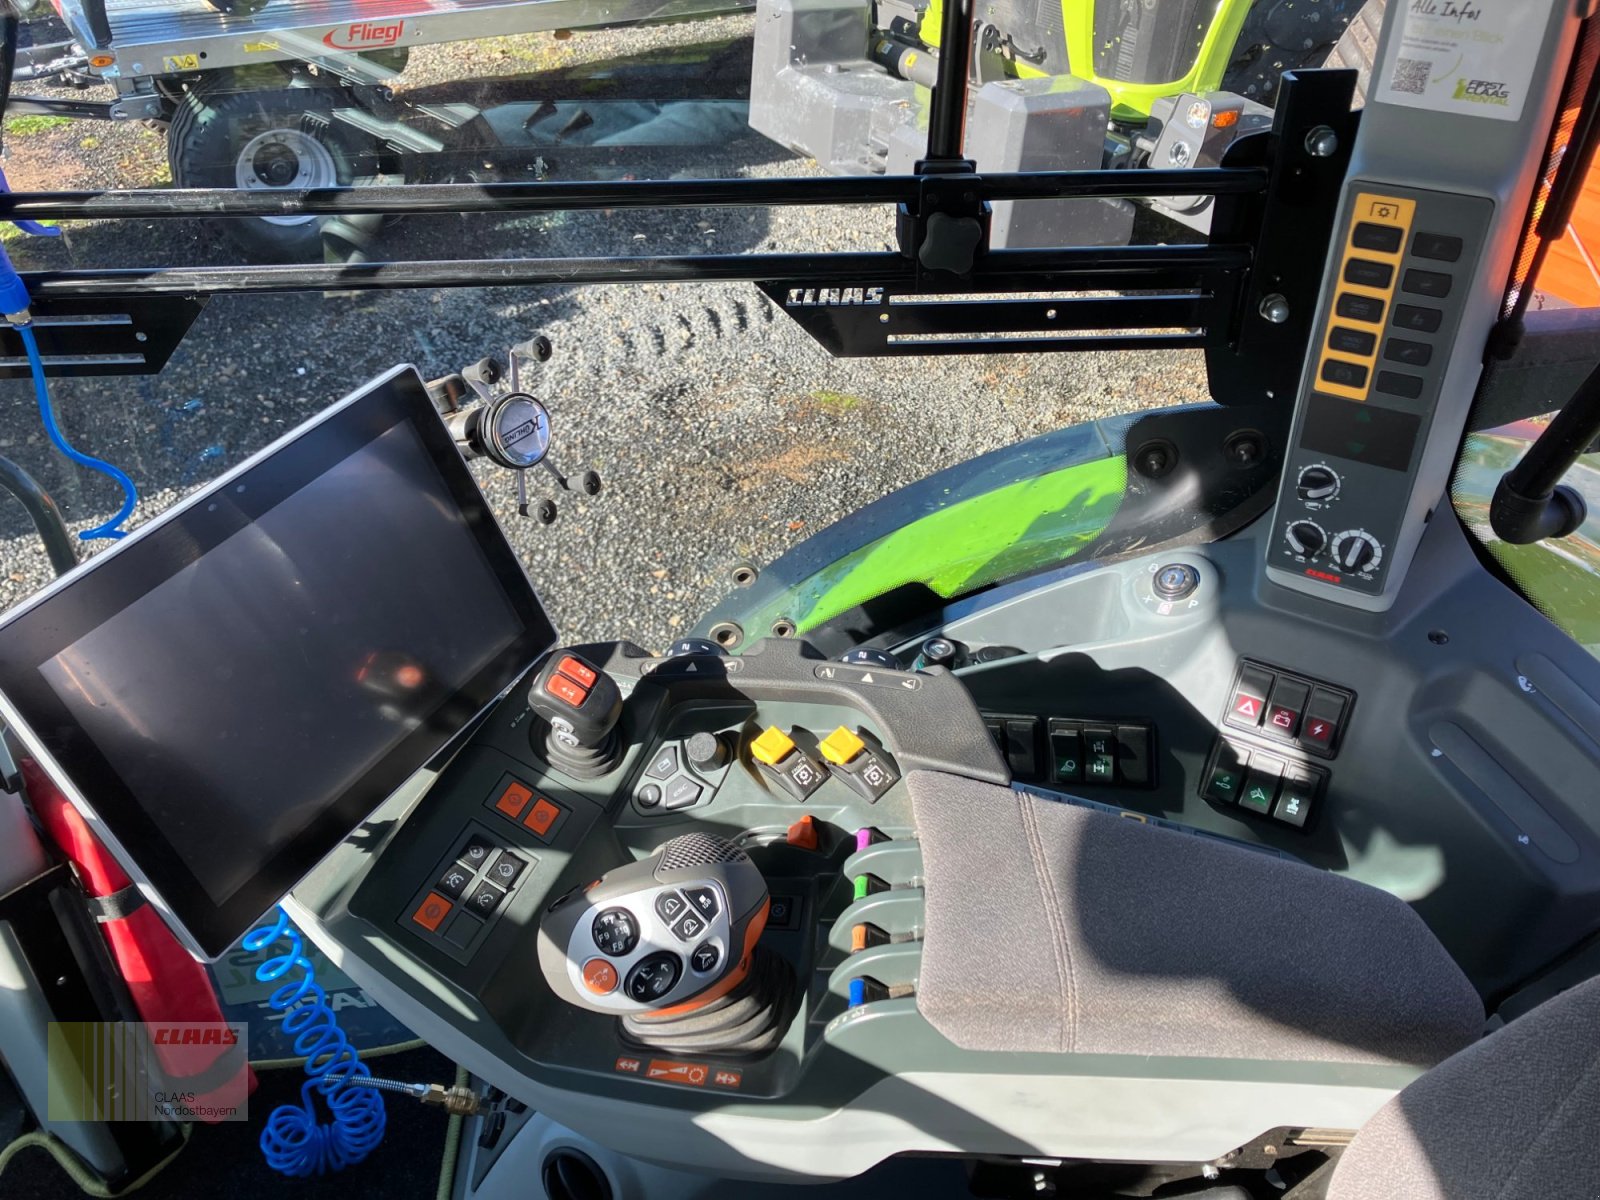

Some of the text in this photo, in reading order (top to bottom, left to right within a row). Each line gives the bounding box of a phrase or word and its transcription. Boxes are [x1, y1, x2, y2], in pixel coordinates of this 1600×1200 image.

[1411, 0, 1482, 24] Alle Infos
[347, 20, 404, 43] Fliegl
[1469, 79, 1507, 91] FIRST
[1465, 86, 1511, 99] CLAAS
[785, 287, 884, 306] CLAAS
[614, 925, 629, 936] F10
[598, 932, 610, 943] F9
[612, 941, 624, 952] F8
